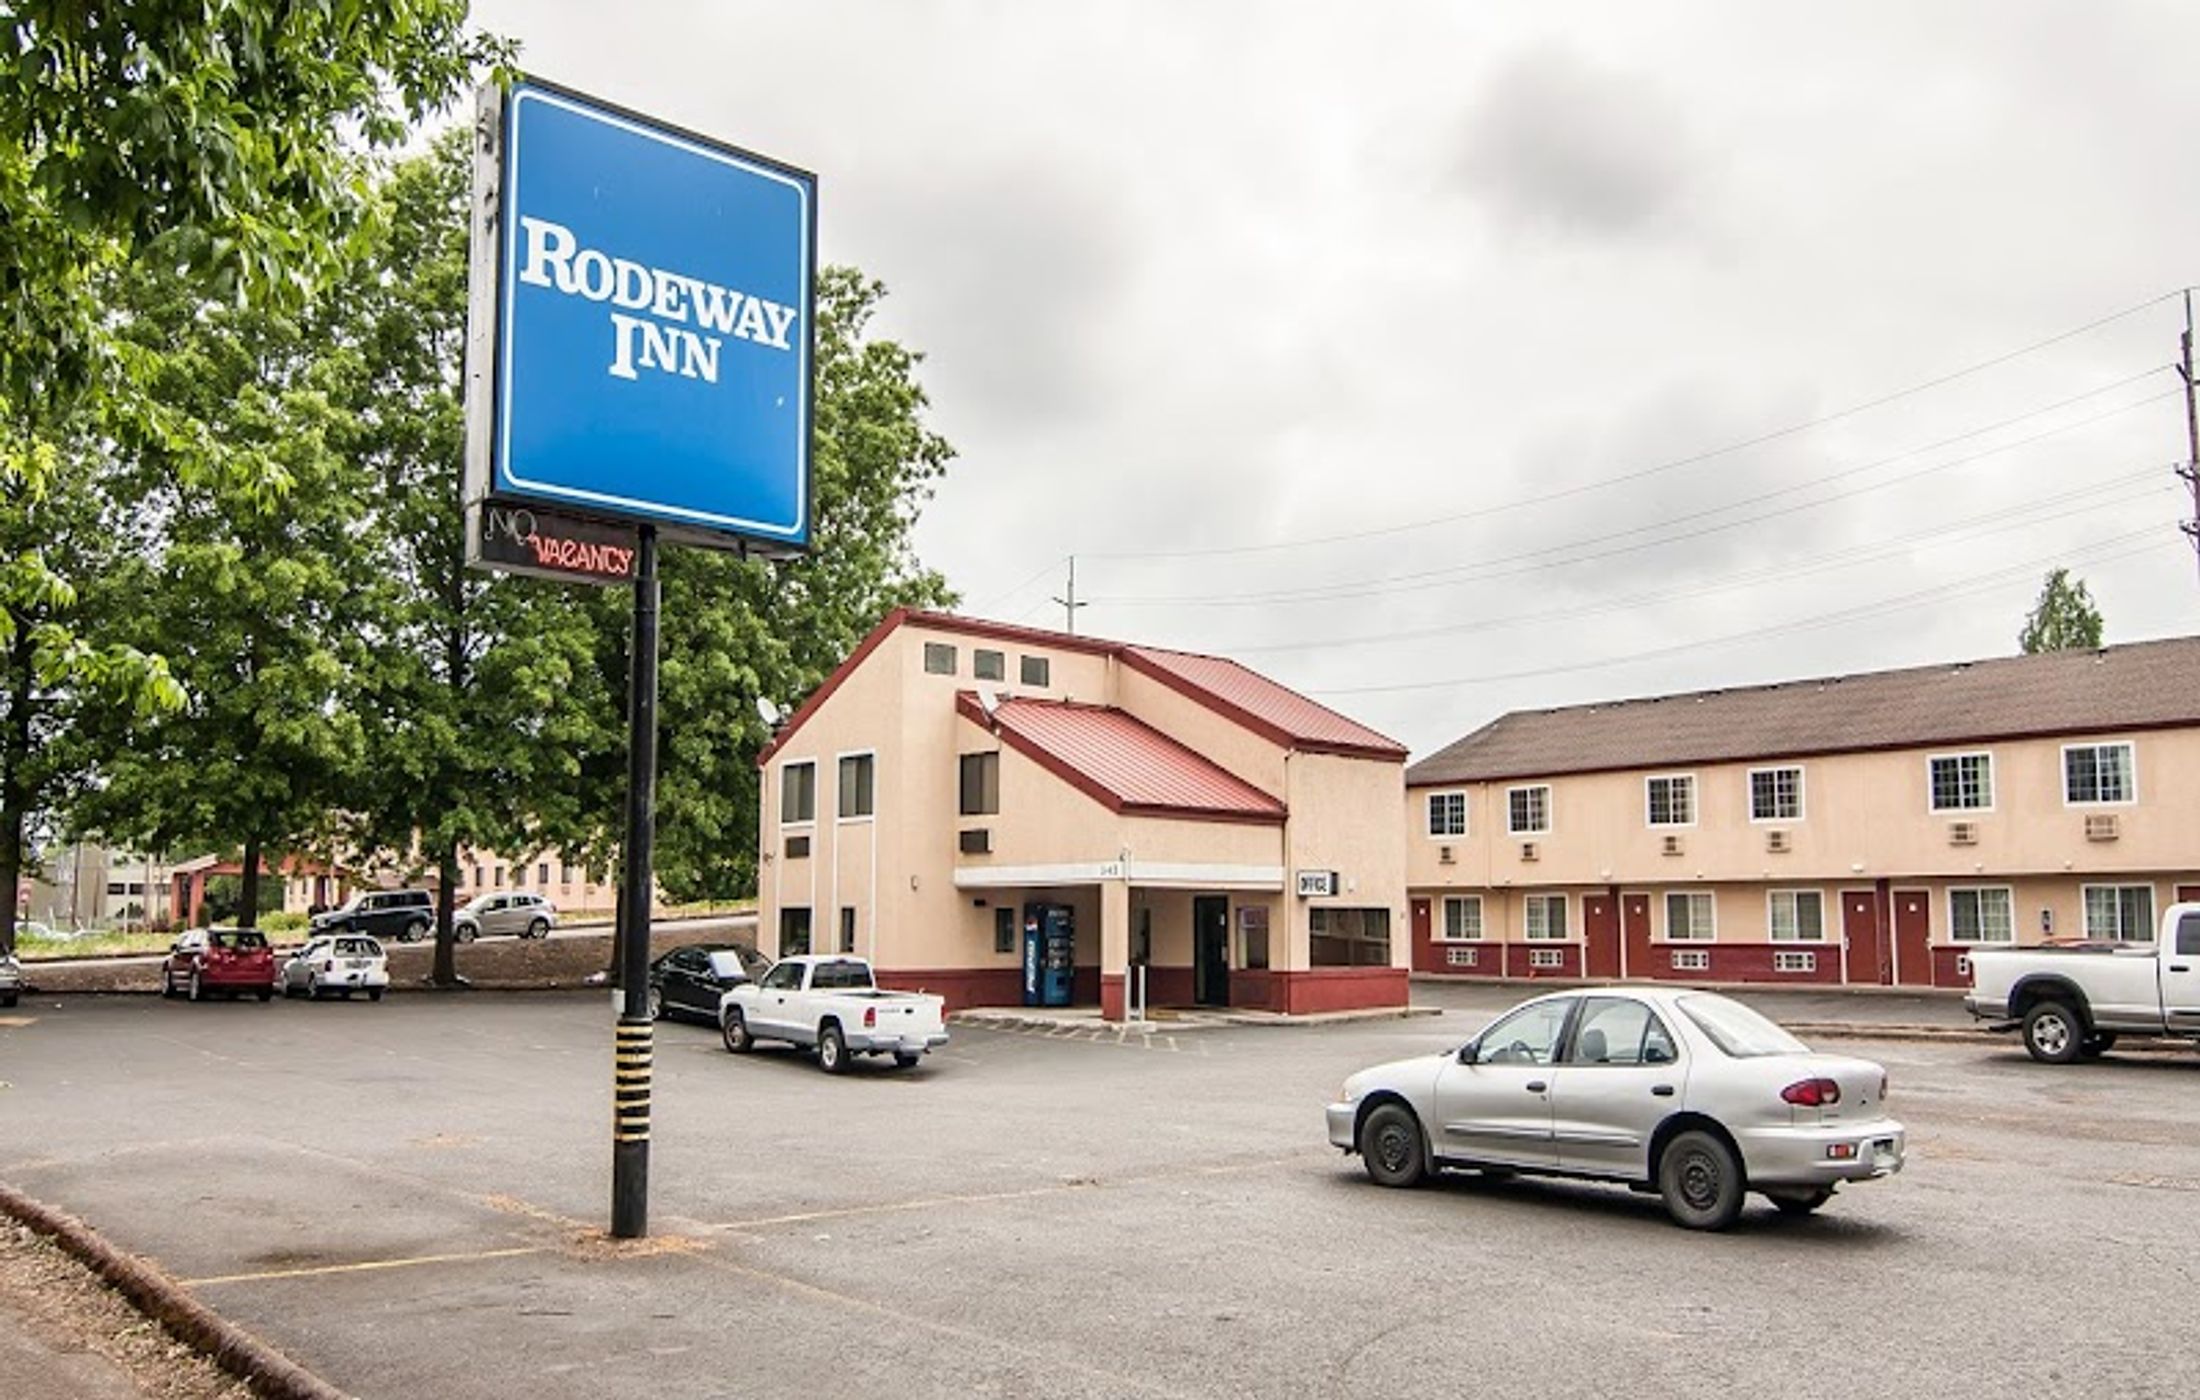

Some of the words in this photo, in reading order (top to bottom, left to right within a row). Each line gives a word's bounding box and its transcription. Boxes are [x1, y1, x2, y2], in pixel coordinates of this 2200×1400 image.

[520, 217, 796, 350] RODEWAY
[609, 313, 721, 383] INN
[484, 508, 537, 546] NO
[528, 533, 634, 574] VACANCY
